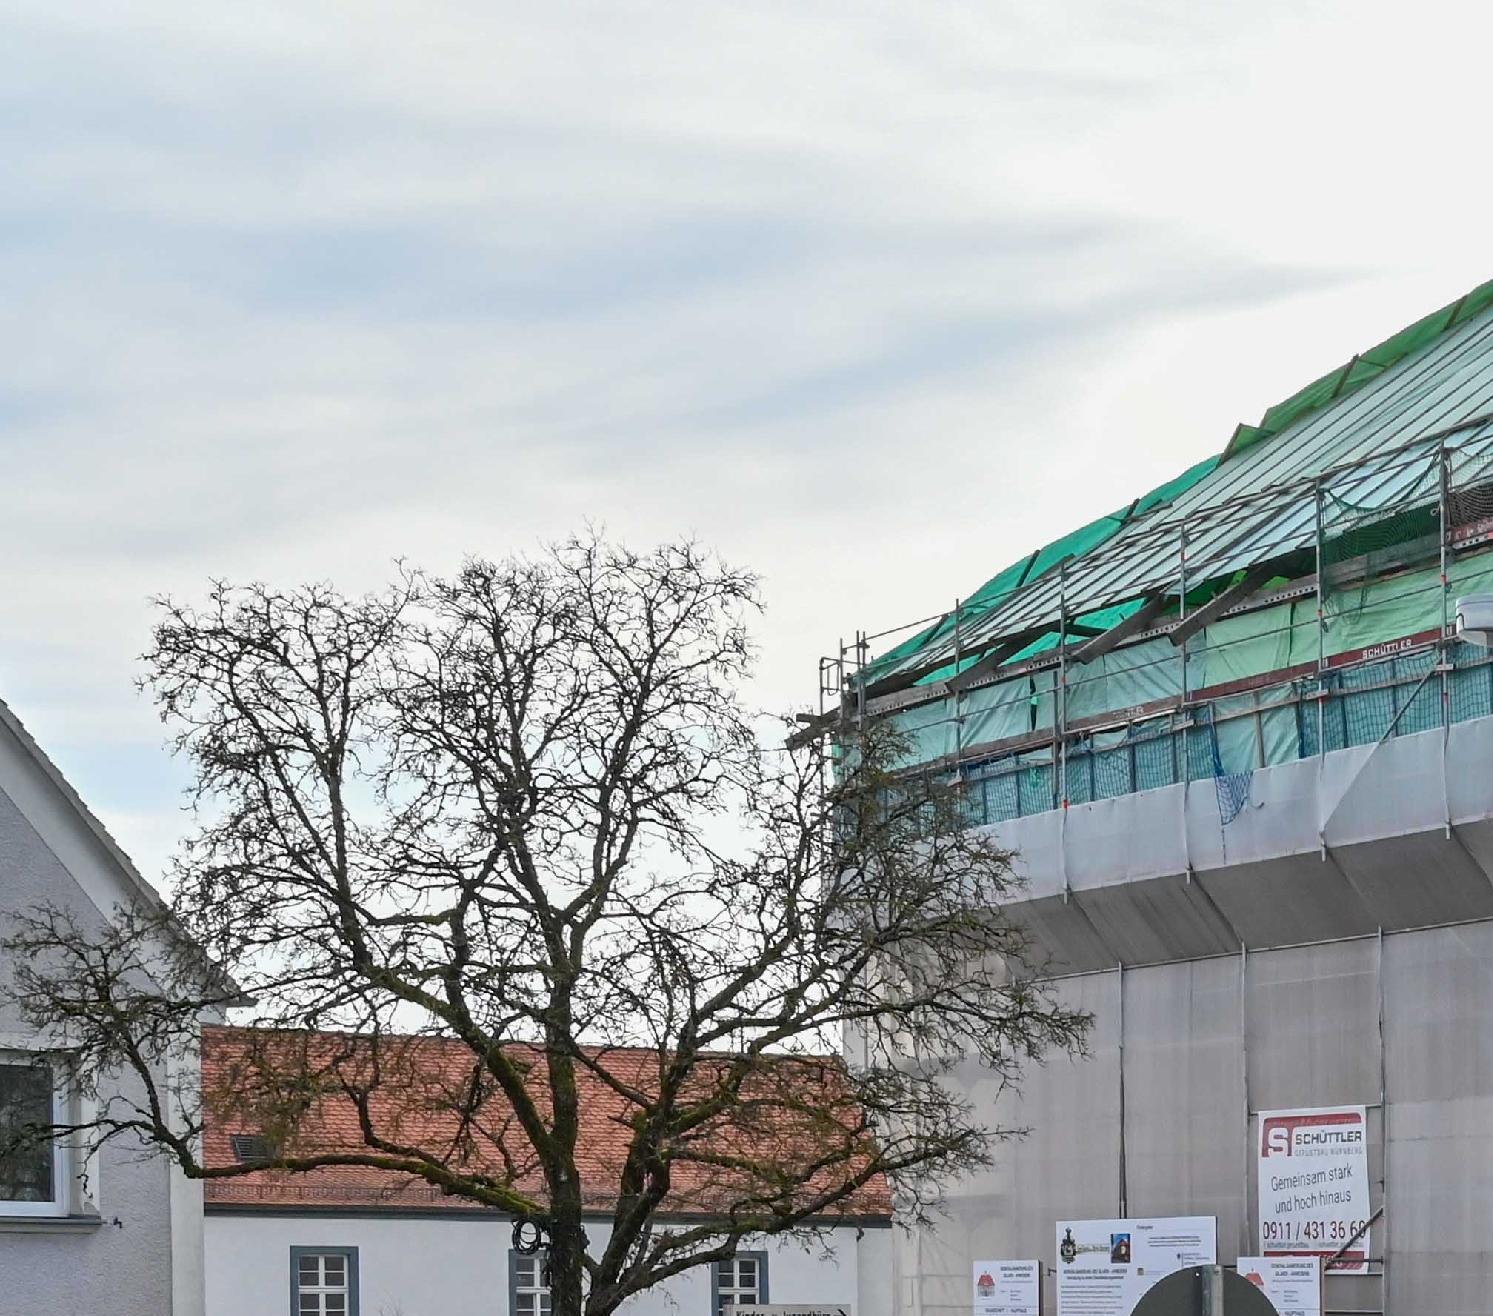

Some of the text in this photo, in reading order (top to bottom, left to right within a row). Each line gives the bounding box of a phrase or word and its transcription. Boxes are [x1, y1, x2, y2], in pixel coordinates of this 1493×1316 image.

[1295, 1129, 1362, 1146] SCHÜTTLER
[1271, 1163, 1353, 1191] Gemeinsam stark
[1275, 1189, 1352, 1214] und hoch hinaus
[1263, 1221, 1292, 1240] 0911
[1304, 1220, 1326, 1240] 431
[1330, 1220, 1346, 1239] 36
[1350, 1219, 1367, 1240] 60
